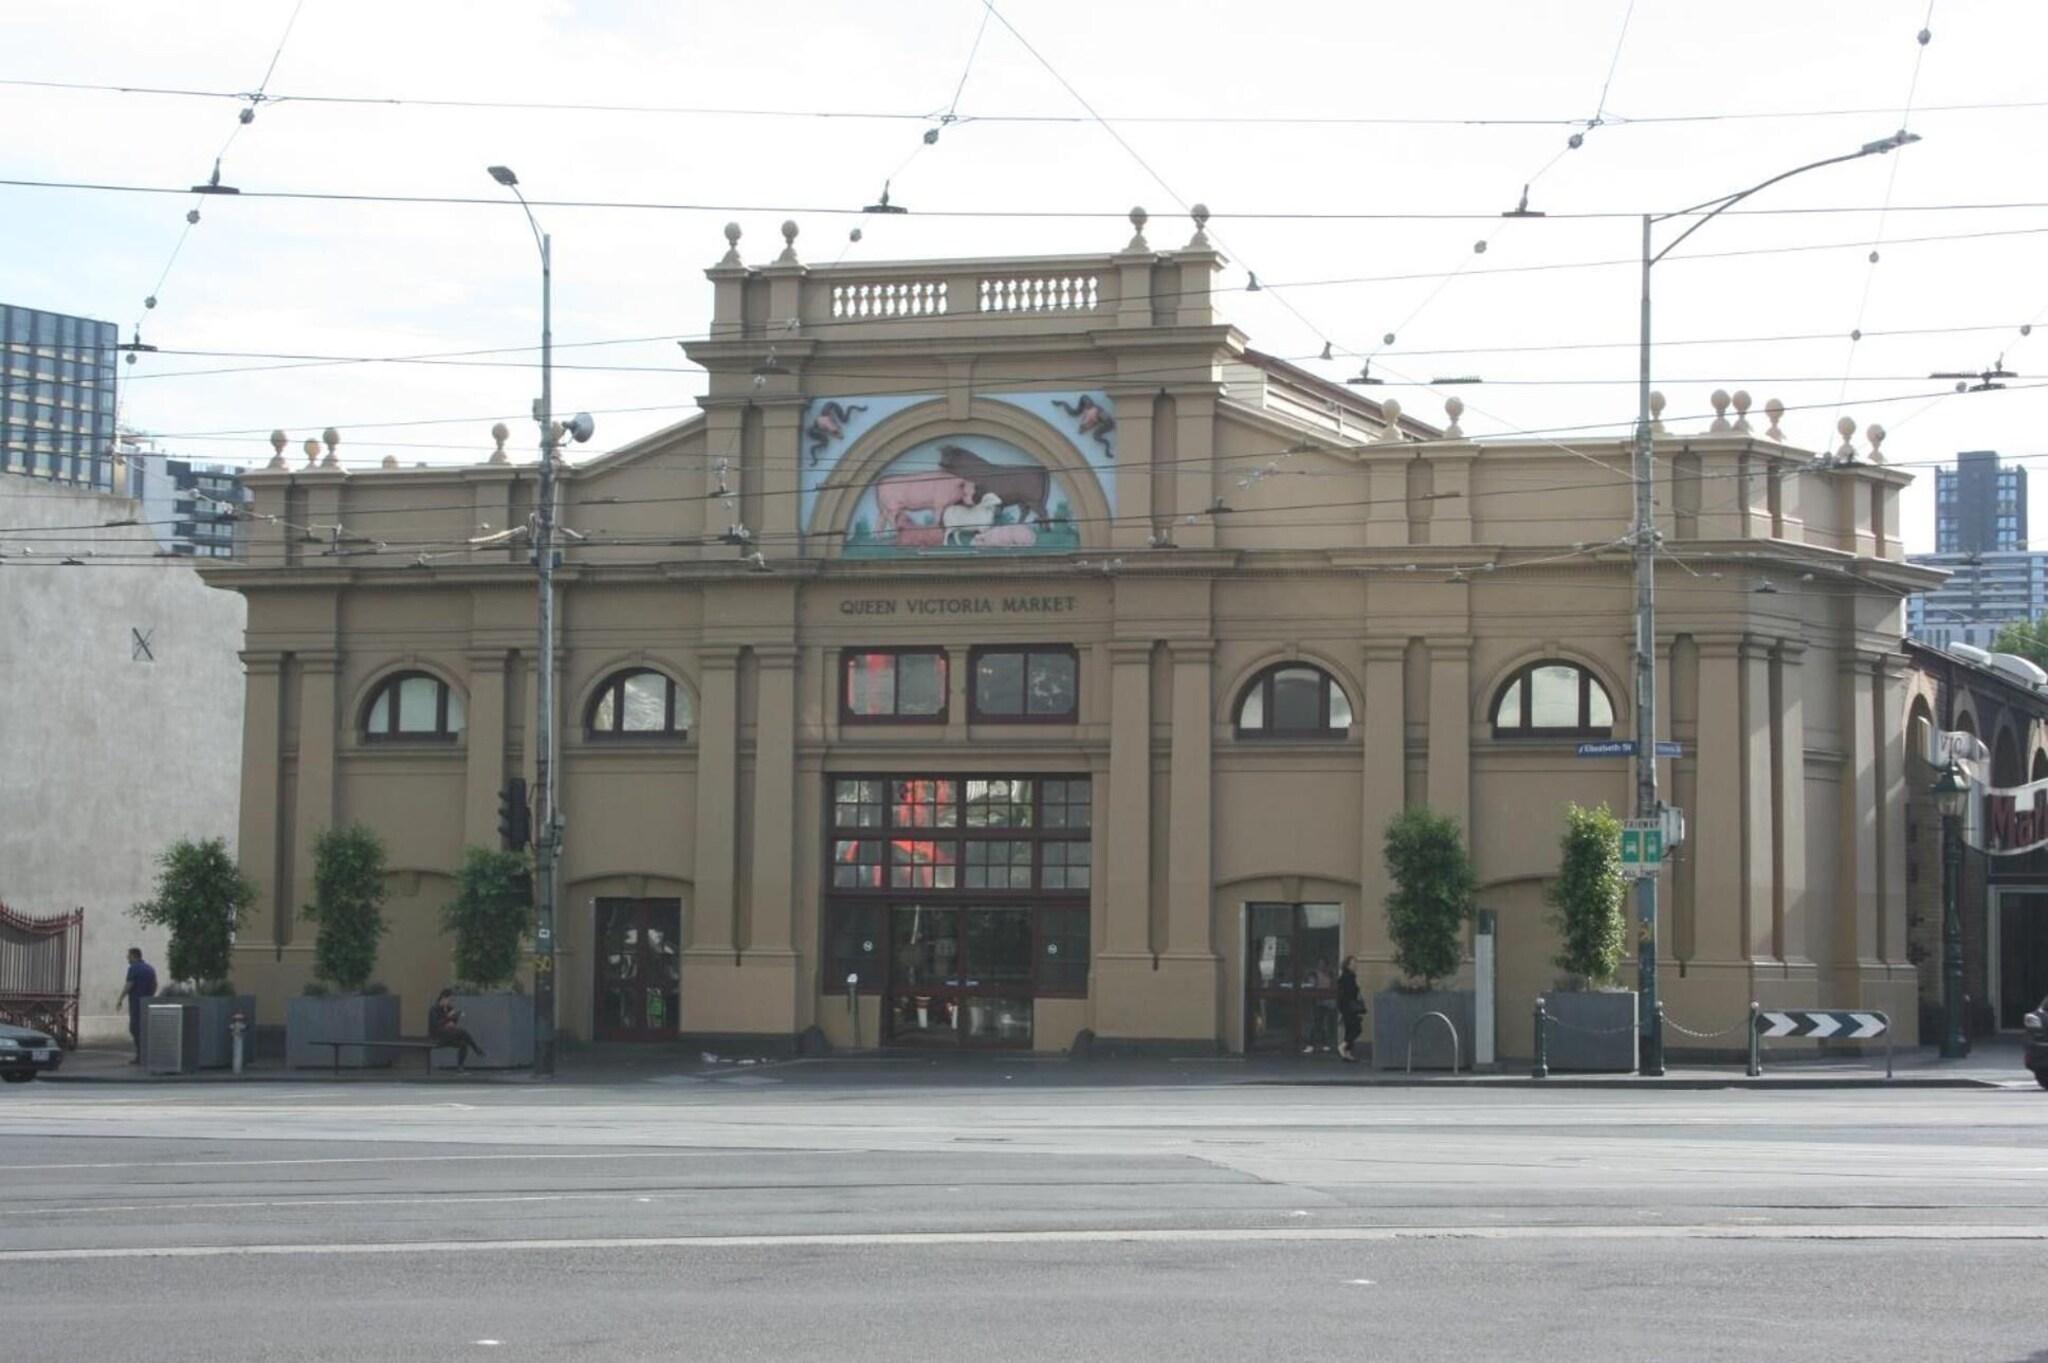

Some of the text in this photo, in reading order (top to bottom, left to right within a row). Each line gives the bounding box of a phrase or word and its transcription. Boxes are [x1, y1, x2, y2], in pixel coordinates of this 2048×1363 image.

[840, 596, 1075, 615] QUEEN VICTORIA MARKET
